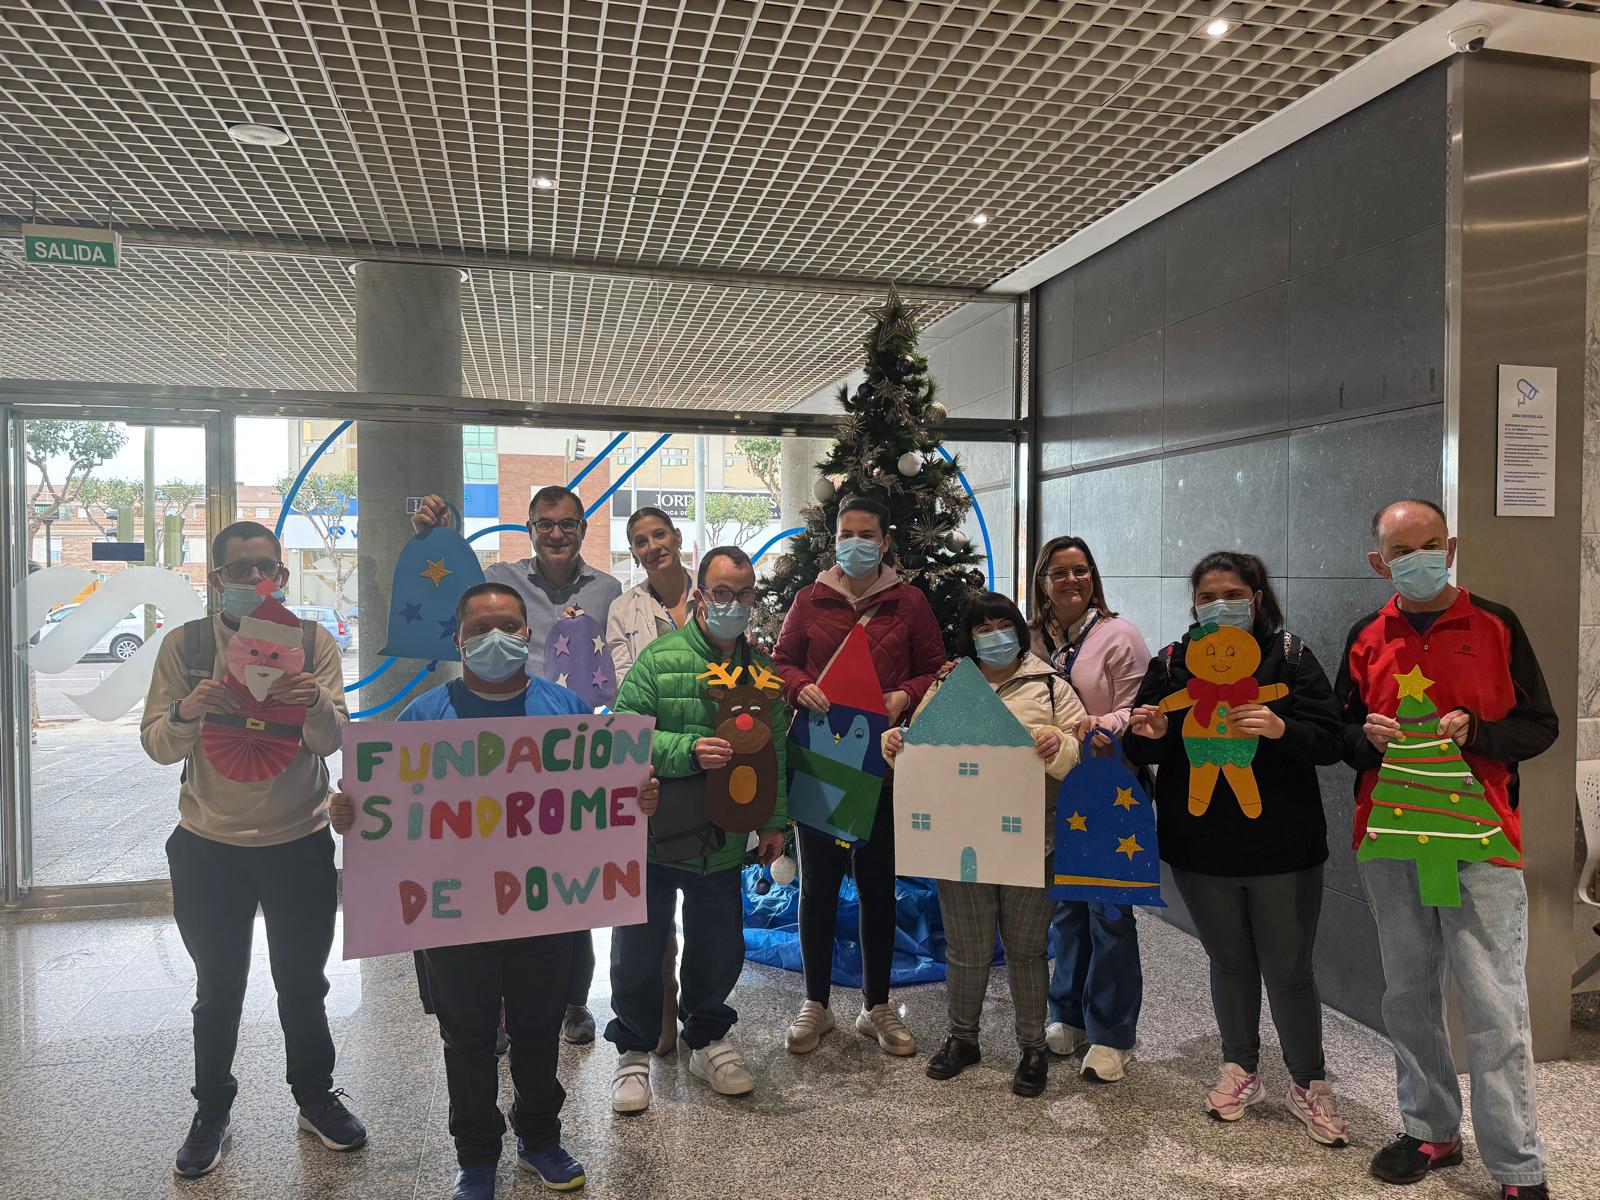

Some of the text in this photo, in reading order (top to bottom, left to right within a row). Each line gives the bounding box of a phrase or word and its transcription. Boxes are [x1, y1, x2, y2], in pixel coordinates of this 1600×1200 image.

[34, 241, 107, 263] SALIDA
[398, 860, 641, 925] DE DOWN
